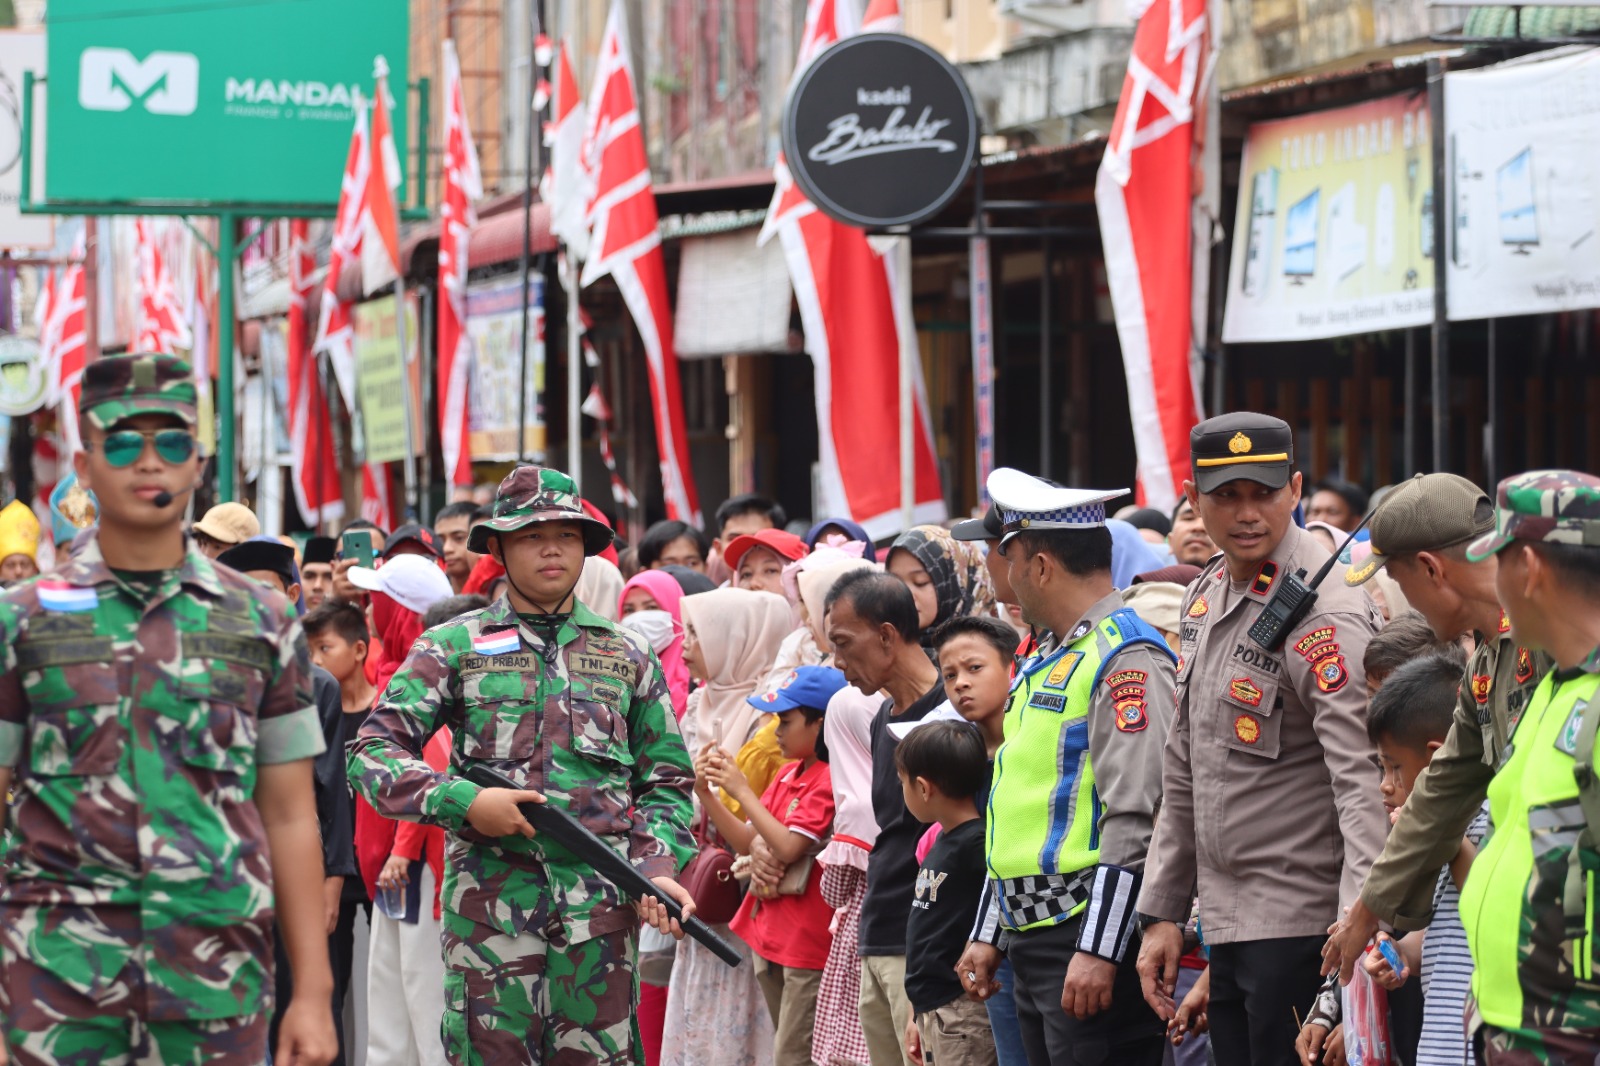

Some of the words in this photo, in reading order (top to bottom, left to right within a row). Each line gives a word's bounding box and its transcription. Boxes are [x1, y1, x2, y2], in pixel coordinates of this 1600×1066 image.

[857, 85, 911, 105] kadai
[1280, 132, 1326, 173] TOKO
[1333, 116, 1394, 163] INDAH
[1297, 629, 1333, 650] POLRES
[1233, 644, 1280, 674] POLRI
[1311, 645, 1335, 659] ACEH
[465, 656, 489, 670] REDY
[492, 655, 530, 668] PRIBADI
[1117, 688, 1141, 697] ACEH
